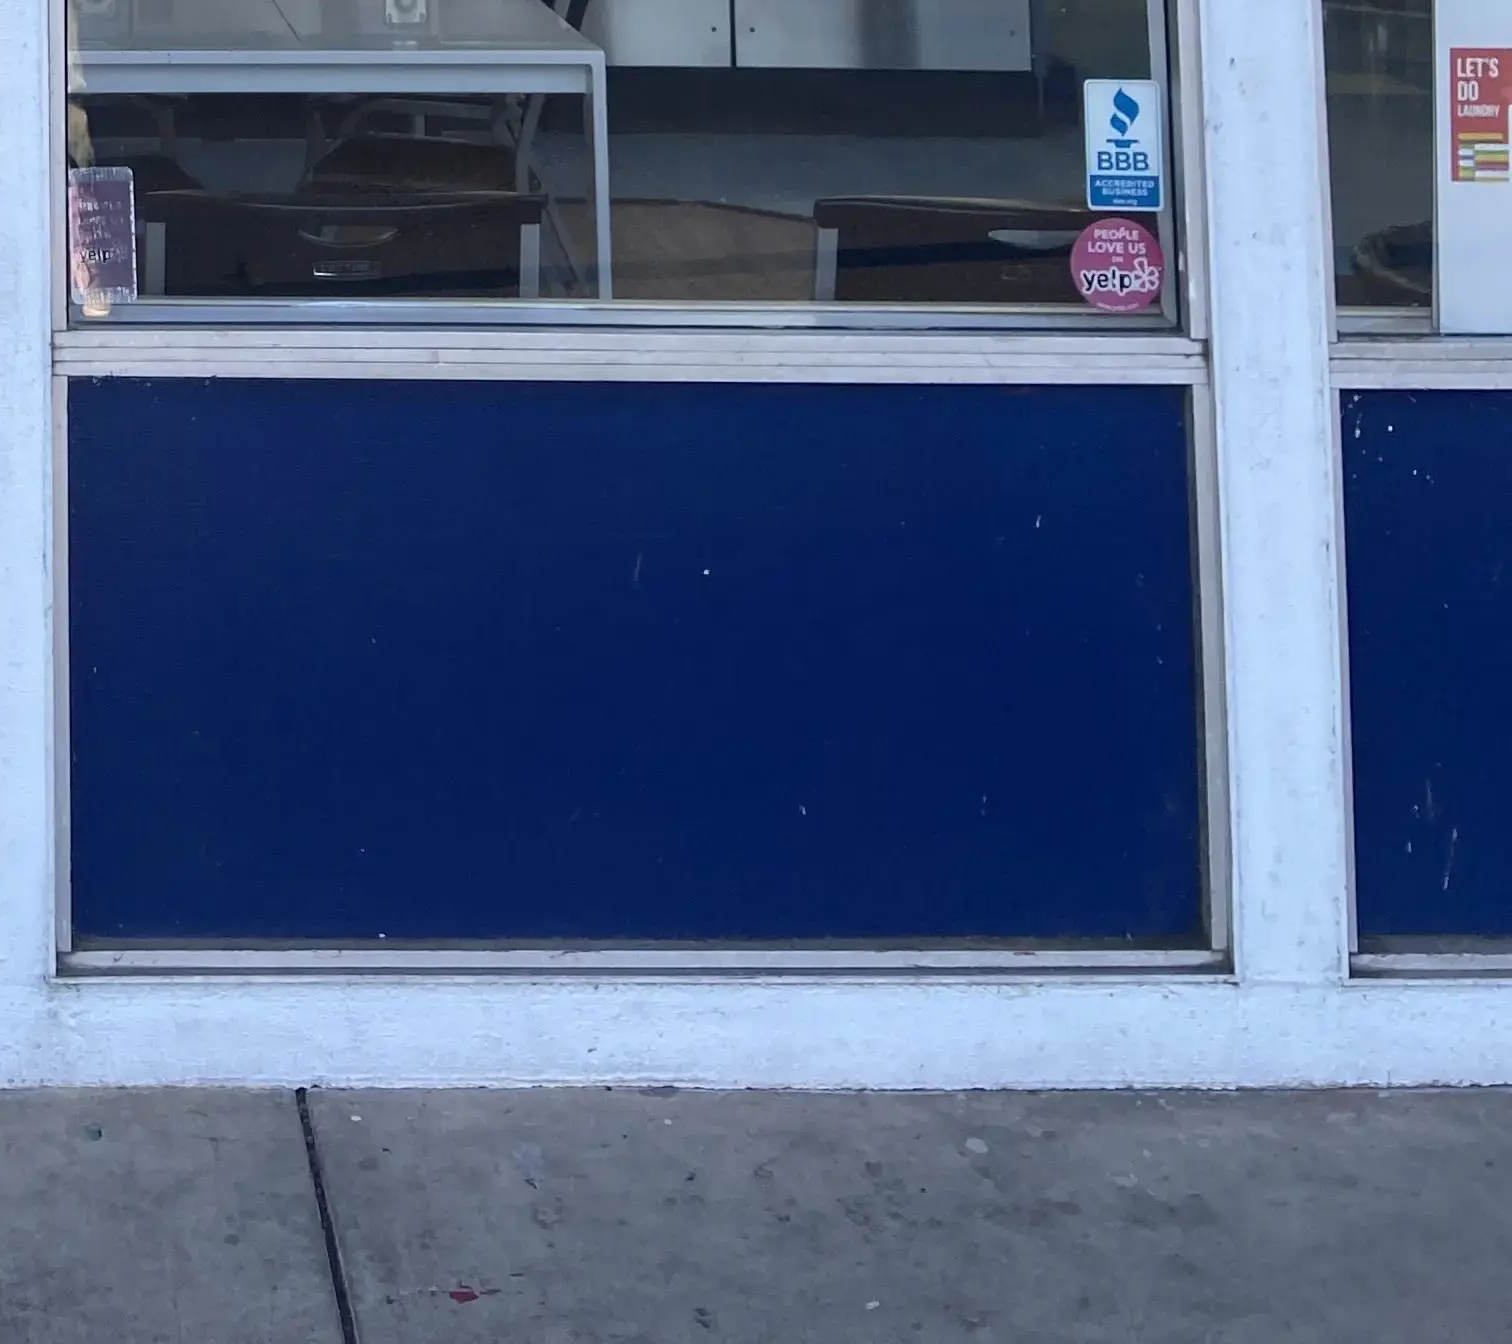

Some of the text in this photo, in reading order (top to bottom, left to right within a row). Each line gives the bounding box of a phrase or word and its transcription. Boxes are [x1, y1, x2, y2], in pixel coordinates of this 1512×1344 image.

[1456, 57, 1500, 79] LET'S
[1457, 80, 1480, 102] DO
[1457, 103, 1500, 119] LAUNDRY
[1096, 151, 1150, 172] BBB
[1094, 178, 1156, 189] ACCREDITED
[1101, 187, 1149, 197] BUSINESS
[1093, 227, 1140, 241] PEOPLE
[1087, 241, 1147, 255] LOVE US
[1080, 266, 1134, 295] yelp
